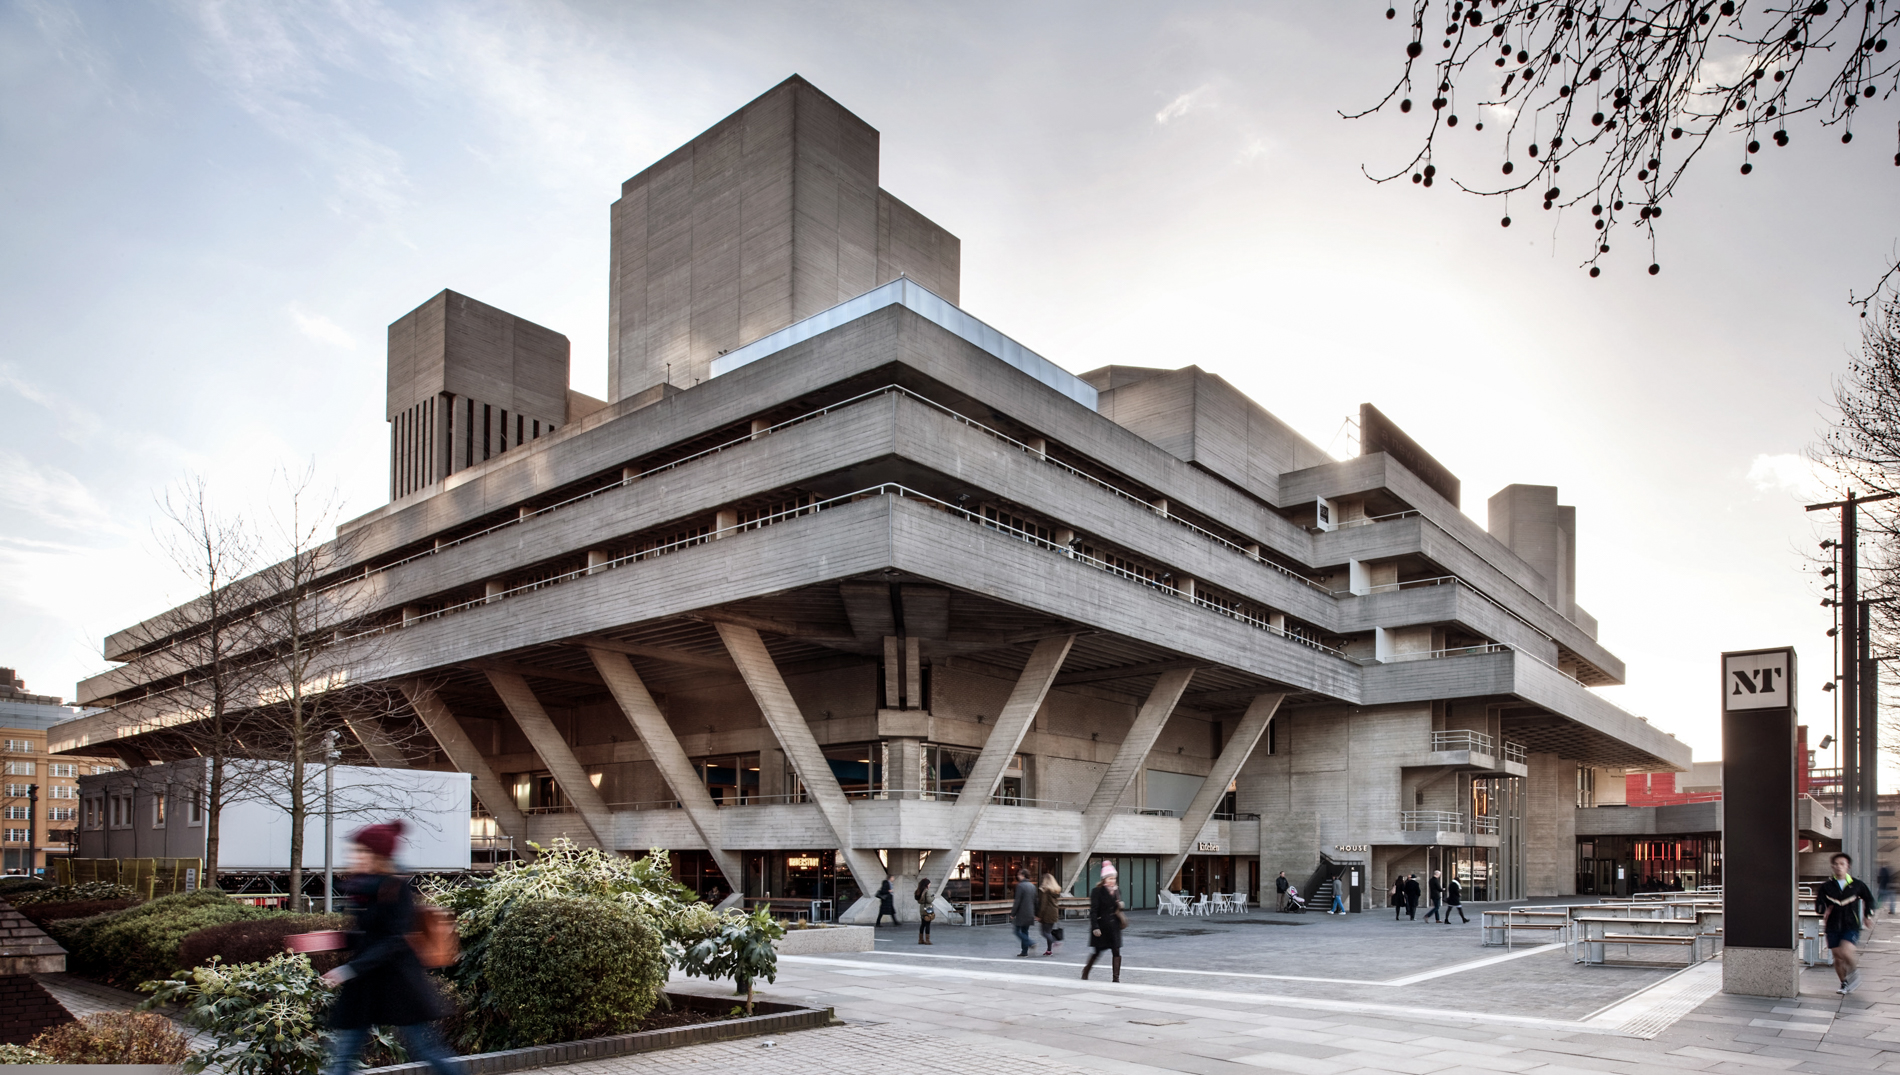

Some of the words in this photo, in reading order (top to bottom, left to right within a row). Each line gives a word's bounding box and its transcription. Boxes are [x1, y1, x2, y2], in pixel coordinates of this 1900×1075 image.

[1392, 438, 1415, 461] new
[1417, 459, 1438, 483] play
[1732, 667, 1781, 695] NT
